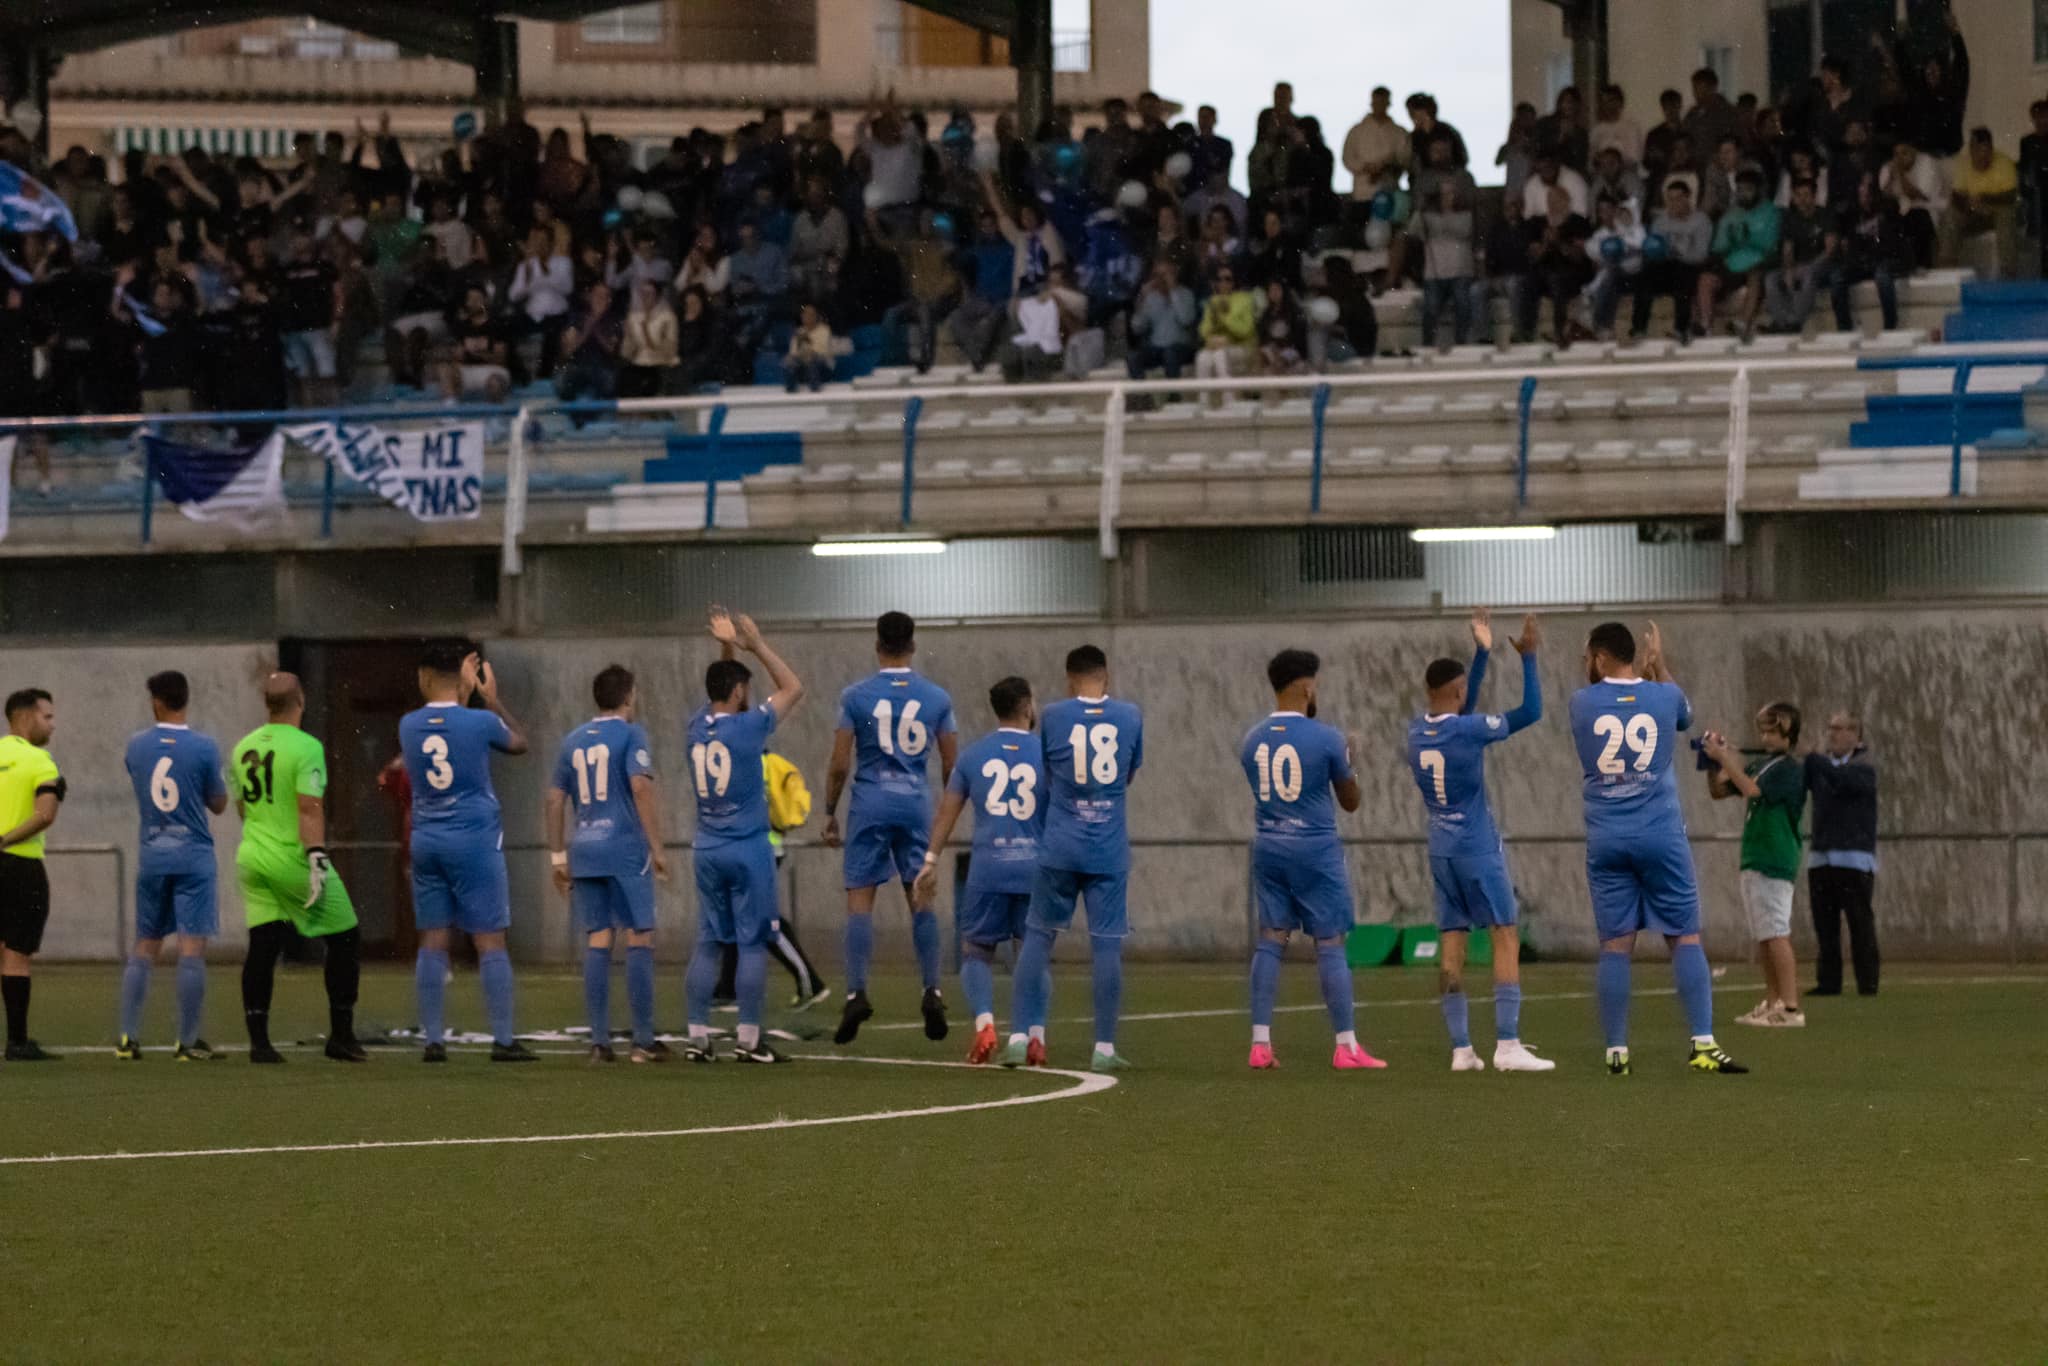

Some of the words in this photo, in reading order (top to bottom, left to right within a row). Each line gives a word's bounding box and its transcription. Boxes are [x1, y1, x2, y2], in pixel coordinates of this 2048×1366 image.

[422, 431, 465, 468] MI
[872, 699, 927, 755] 16
[1068, 723, 1119, 785] 18
[1593, 713, 1658, 775] 29
[150, 756, 180, 812] 6
[241, 749, 275, 804] 31
[422, 734, 454, 790] 3
[572, 743, 610, 805] 17
[691, 740, 732, 798] 19
[981, 758, 1037, 821] 23
[1254, 743, 1302, 802] 10
[1419, 749, 1448, 806] 7
